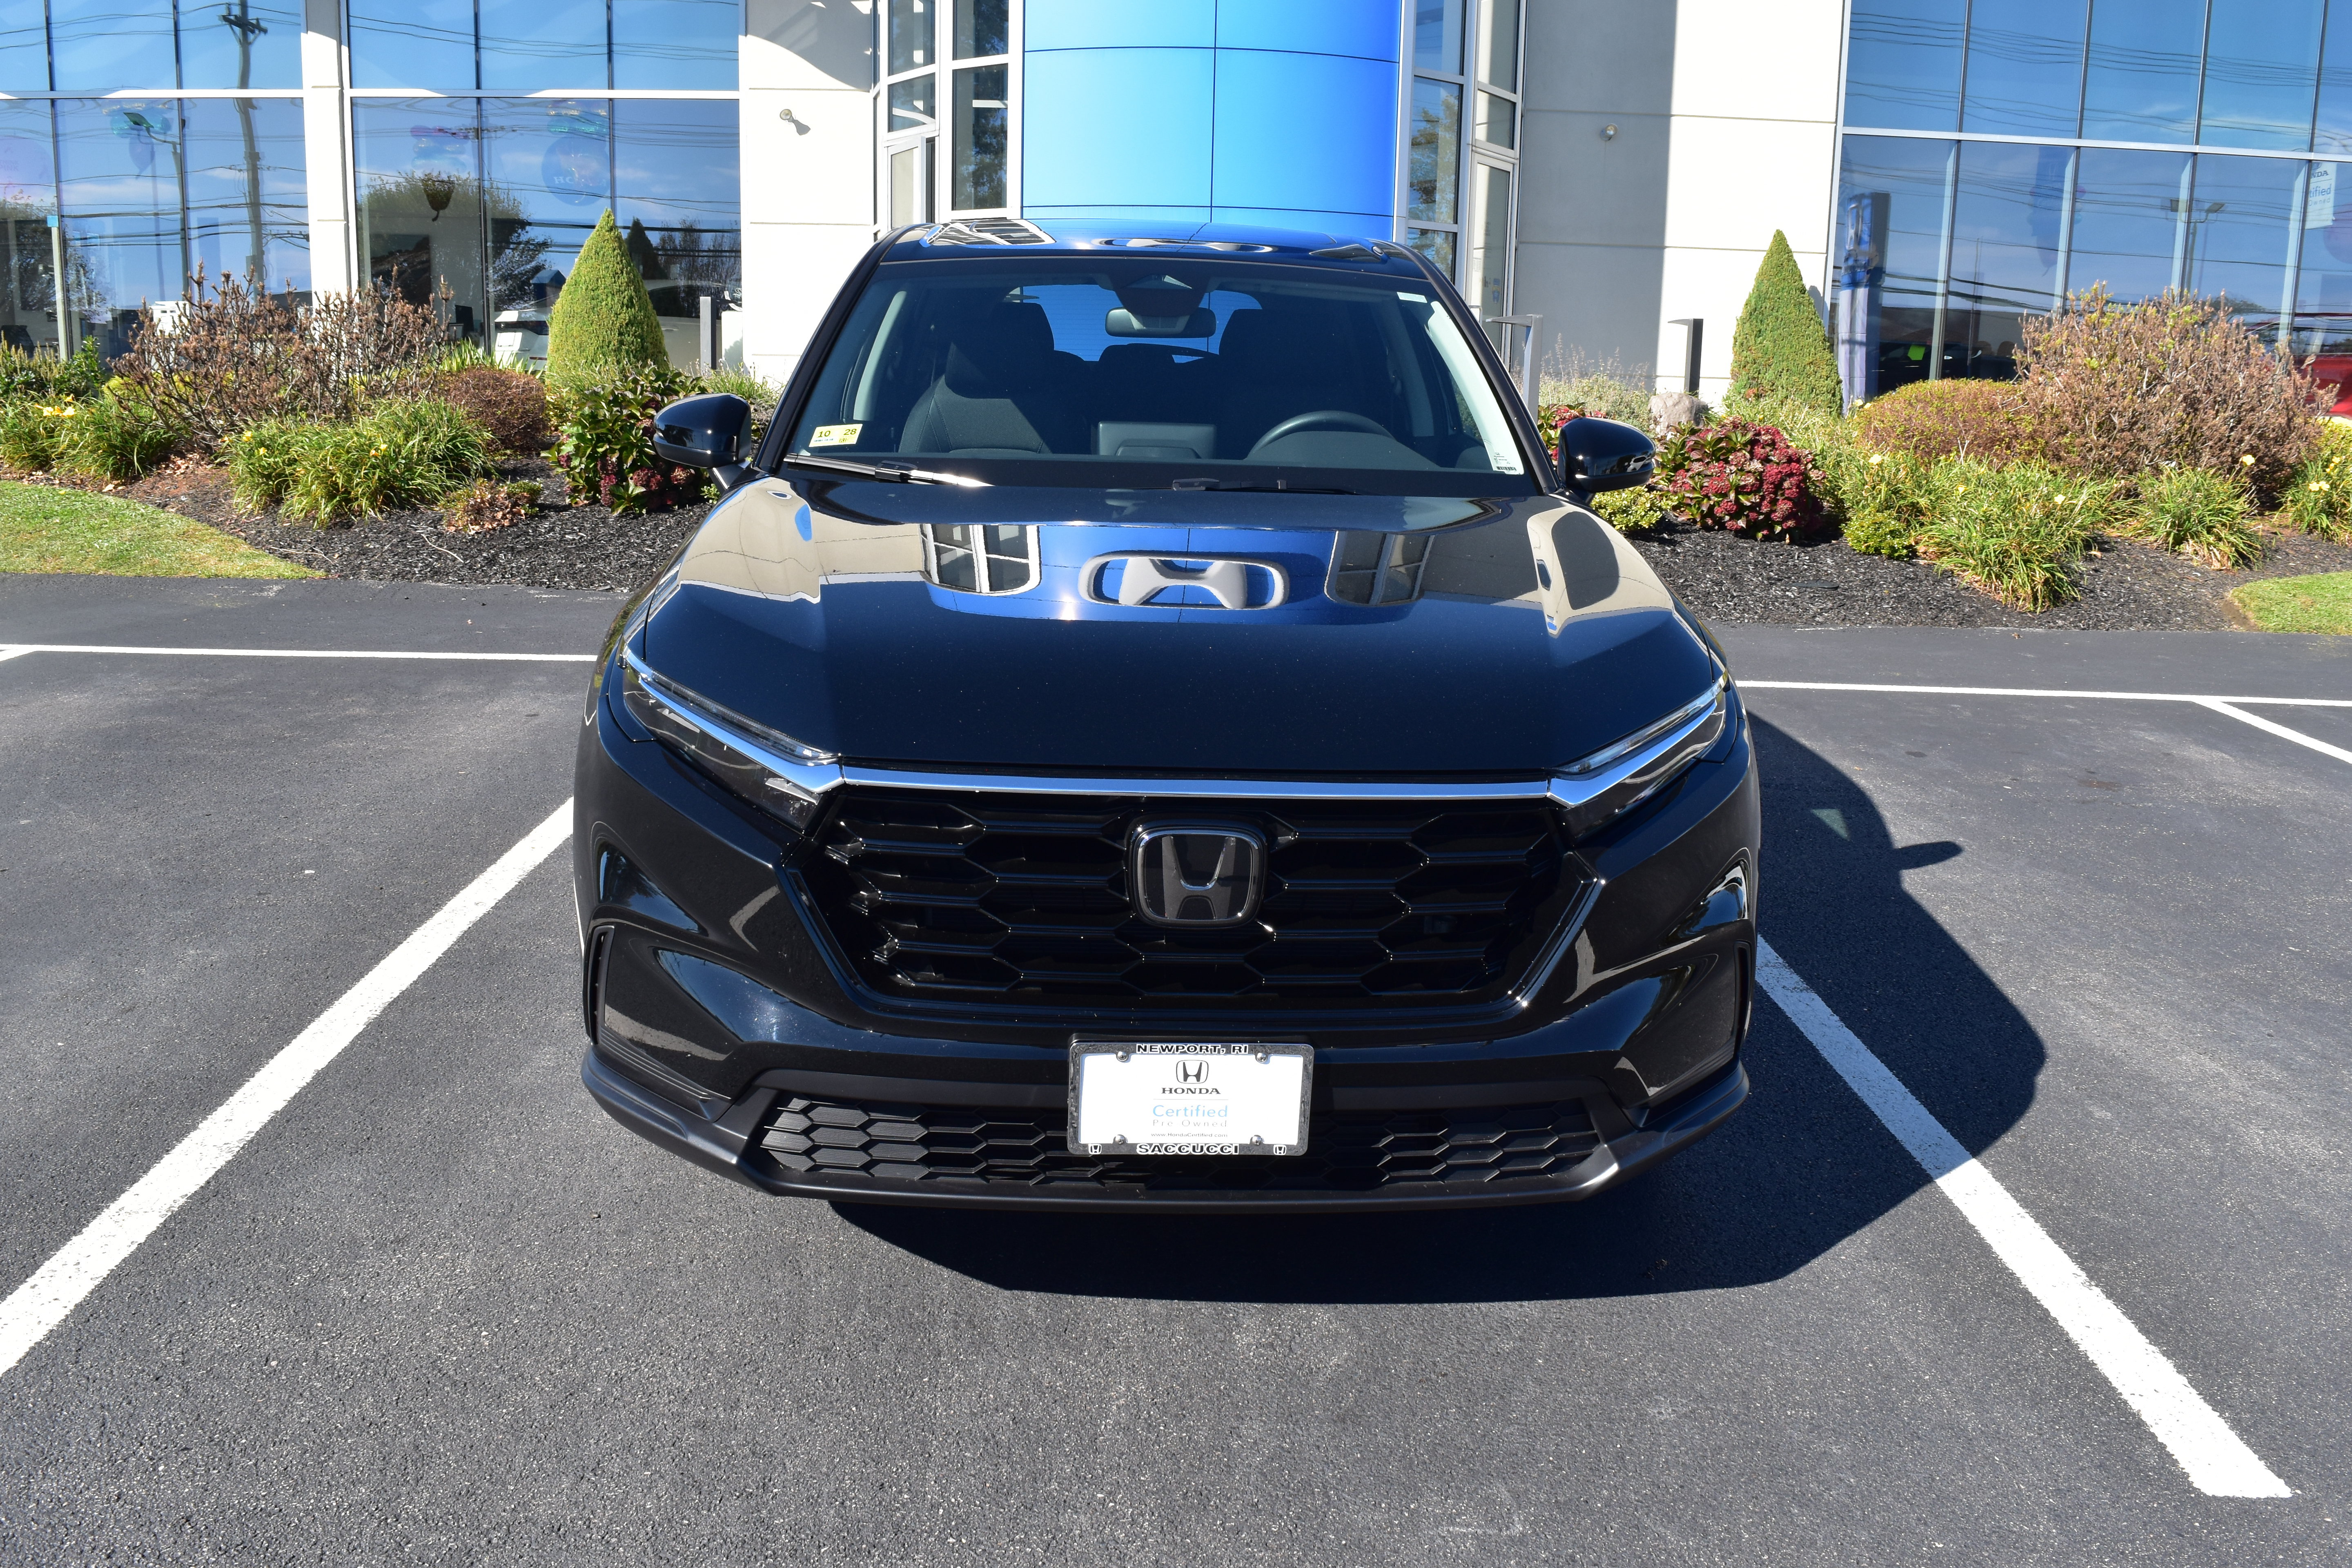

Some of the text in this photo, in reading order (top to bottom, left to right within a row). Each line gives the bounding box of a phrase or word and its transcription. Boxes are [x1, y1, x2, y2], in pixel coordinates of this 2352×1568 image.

[2311, 170, 2329, 179] NDA
[2309, 184, 2332, 198] tified
[1137, 1044, 1248, 1054] NEWPORT, RI
[1153, 1105, 1227, 1117] Certified
[1137, 1143, 1239, 1154] SACCUCCI
